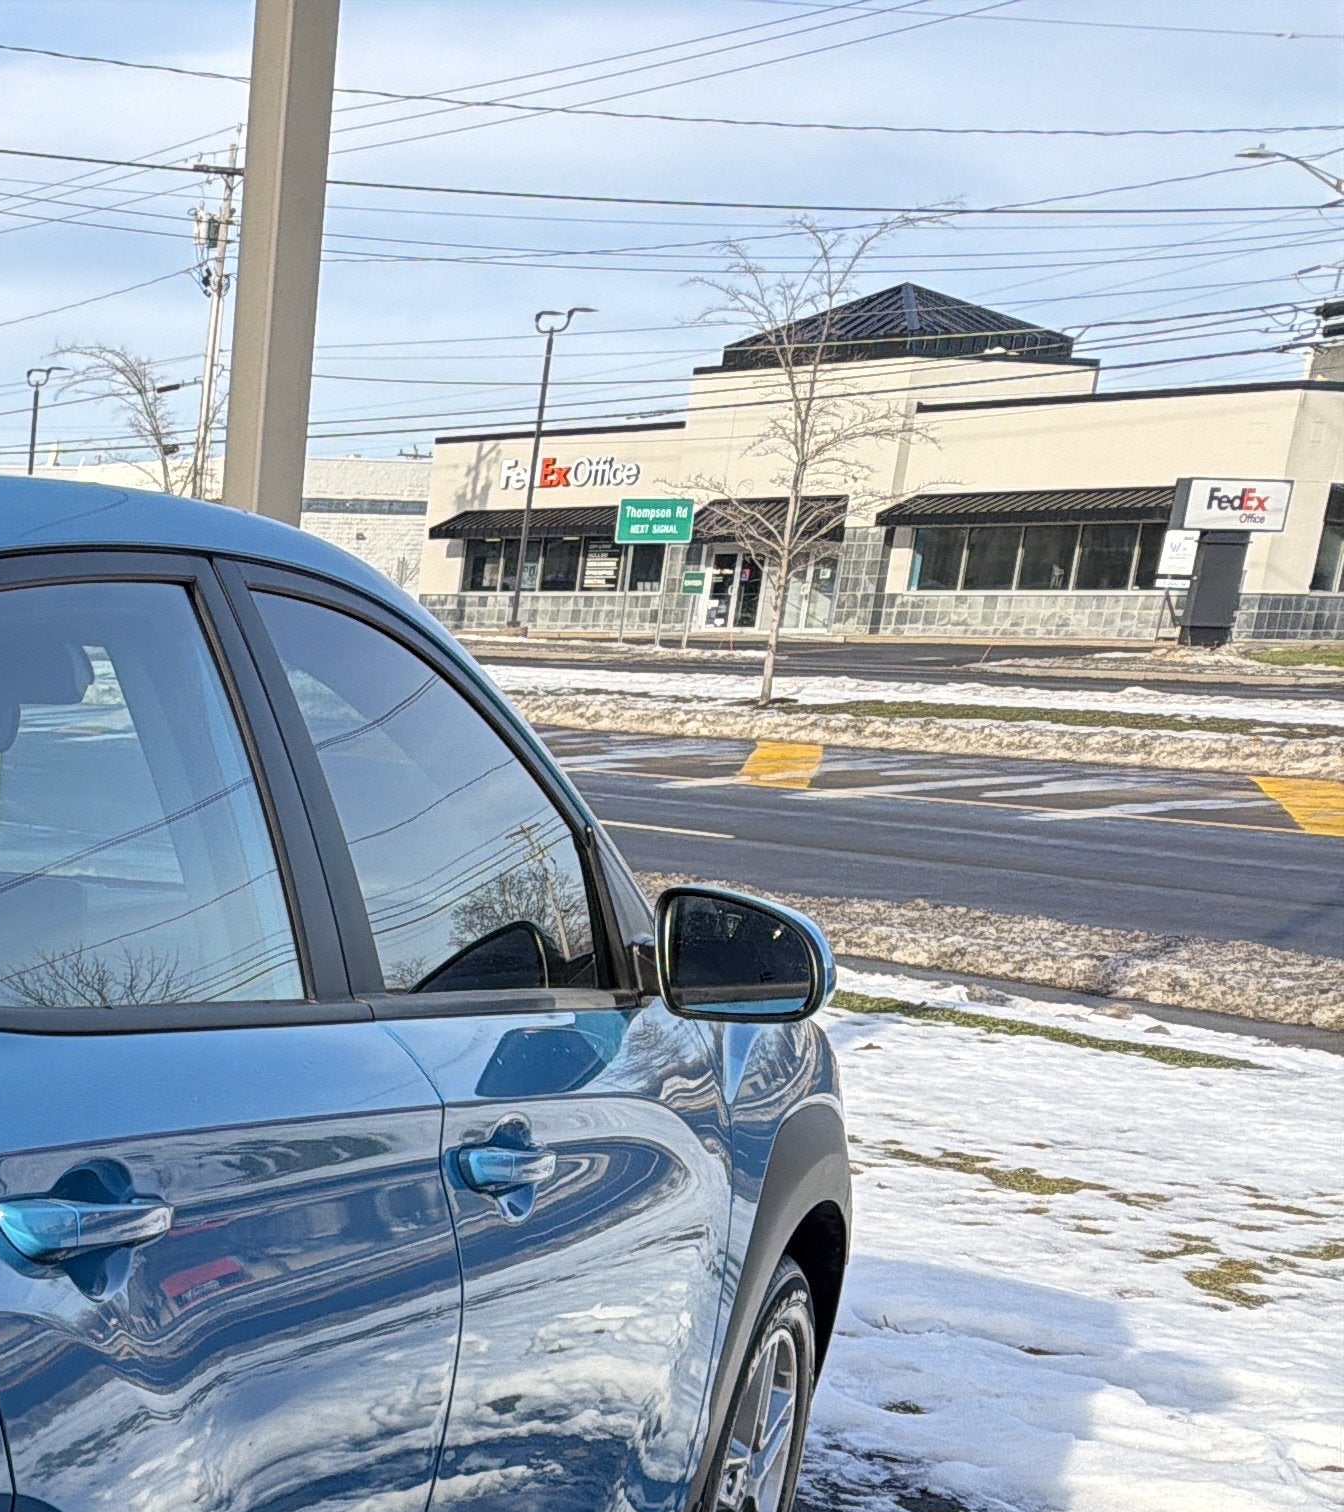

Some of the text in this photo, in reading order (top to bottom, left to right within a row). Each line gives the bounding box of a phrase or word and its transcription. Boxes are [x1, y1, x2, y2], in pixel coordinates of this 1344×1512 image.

[571, 456, 641, 488] Office
[1206, 486, 1270, 512] FedEx
[625, 505, 689, 521] Thompson Rd
[1239, 512, 1266, 524] Office
[629, 524, 679, 534] NEXT SIGNAL
